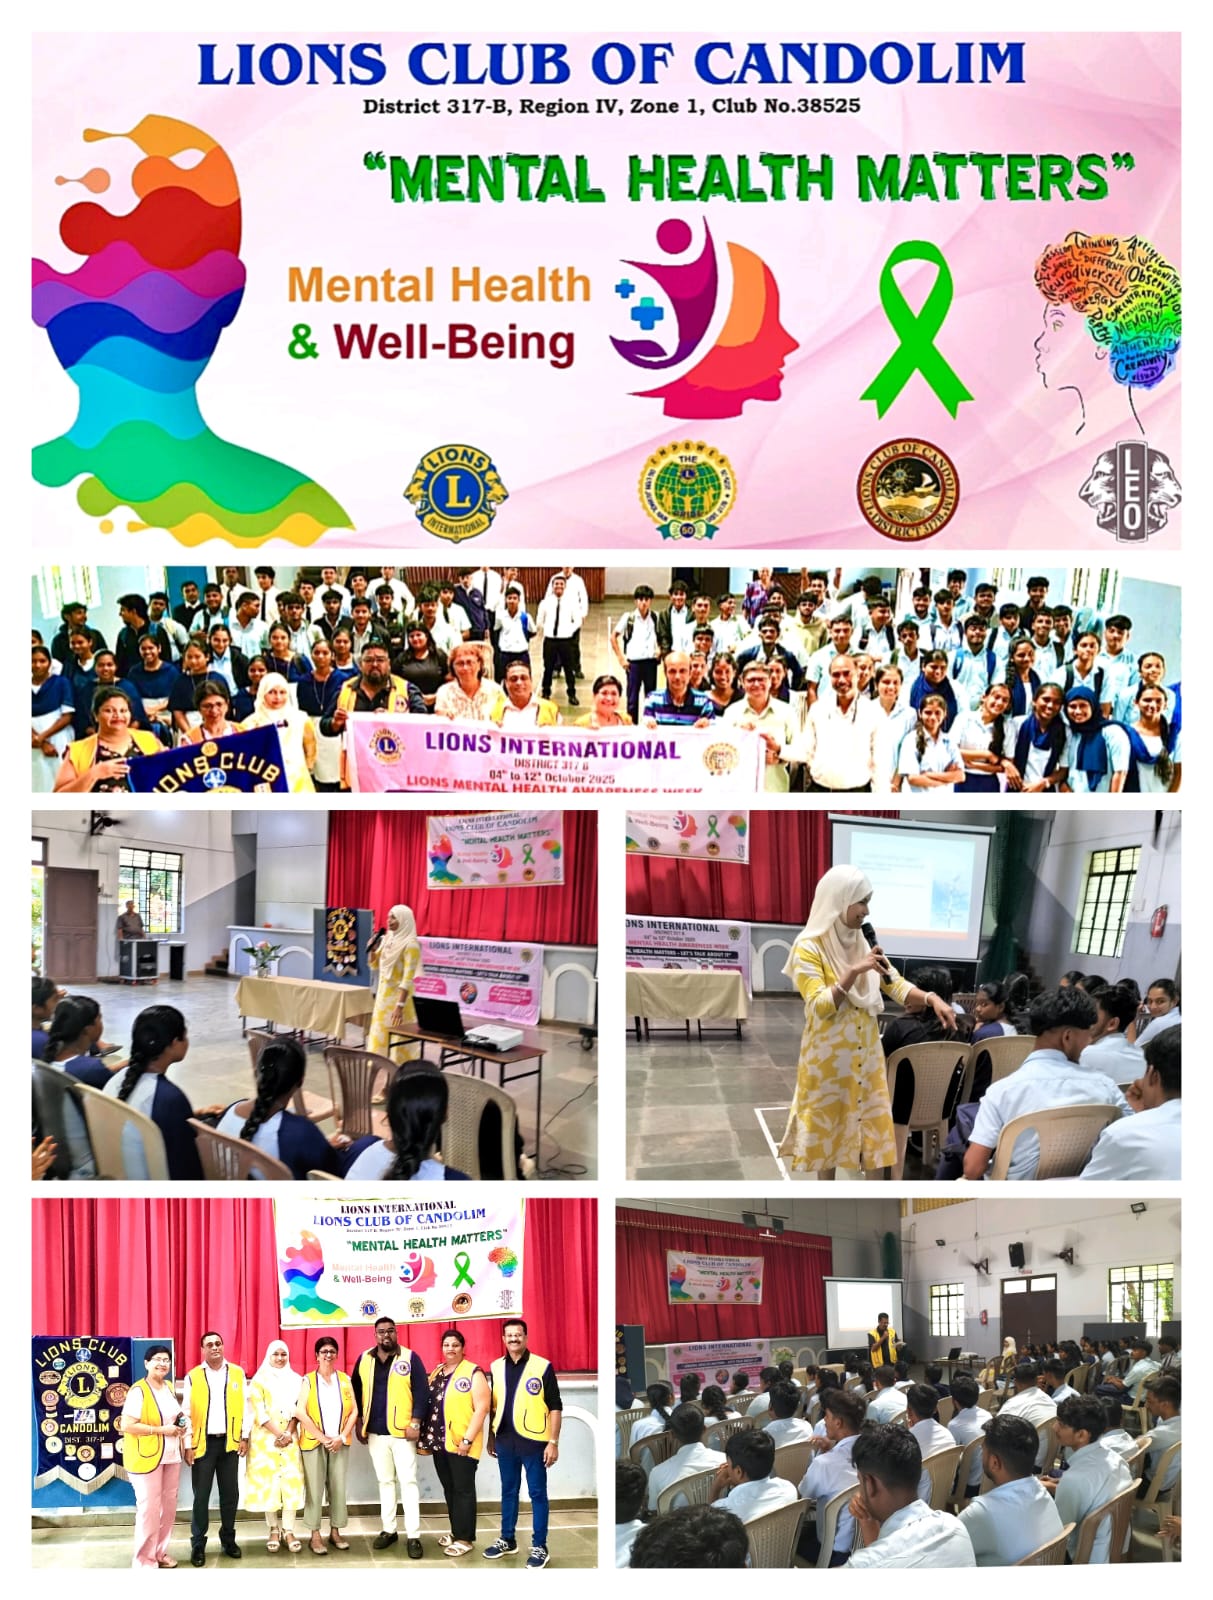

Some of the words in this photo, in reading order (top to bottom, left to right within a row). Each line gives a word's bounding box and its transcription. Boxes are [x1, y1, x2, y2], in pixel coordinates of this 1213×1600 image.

[197, 43, 386, 85] LIONS
[408, 42, 571, 85] CLUB
[591, 42, 675, 85] OF
[694, 42, 1026, 84] CANDOLIM
[363, 98, 440, 114] District
[446, 98, 512, 116] 317-B,
[520, 98, 590, 117] Region
[595, 98, 623, 116] IV,
[630, 98, 679, 114] Zone
[687, 98, 704, 116] 1,
[712, 97, 757, 114] Club
[764, 98, 860, 114] No.38525
[628, 152, 834, 203] HEALTH
[288, 266, 433, 302] Mental
[452, 266, 590, 302] Health
[288, 323, 319, 359] &
[333, 323, 575, 369] Well-Being
[427, 448, 486, 469] LIONS
[678, 455, 698, 463] THE
[861, 471, 873, 513] LIONS
[870, 445, 900, 470] CLUB
[902, 443, 920, 453] OF
[922, 447, 955, 512] CANDOLIM
[445, 475, 471, 507] L
[1123, 448, 1142, 530] LEO
[428, 517, 486, 535] INTERNATIONAL
[871, 512, 921, 537] DISTRICT
[381, 738, 395, 753] L
[425, 732, 491, 753] LIONS
[501, 737, 681, 760] INTERNATIONAL
[220, 752, 280, 782] CLUB
[514, 758, 558, 769] DISTRICT
[407, 775, 449, 787] LIONS
[453, 779, 508, 792] MENTAL
[513, 783, 567, 792] HEALTH
[510, 772, 521, 781] to
[545, 773, 586, 784] October
[589, 774, 615, 785] 2025
[647, 921, 720, 932] INTERNATIONAL
[429, 942, 450, 950] LIONS
[452, 943, 512, 954] INTERNATIONAL
[340, 1203, 370, 1214] LIONS
[373, 1200, 456, 1214] INTERNATIONAL
[314, 1214, 351, 1226] LIONS
[355, 1214, 391, 1227] CLUB
[395, 1213, 411, 1225] OF
[416, 1208, 486, 1225] CANDOLIM
[403, 1236, 447, 1250] HEALTH
[332, 1262, 362, 1272] Mental
[365, 1262, 396, 1272] Health
[333, 1274, 340, 1283] &
[342, 1274, 392, 1284] Well-Being
[35, 1337, 81, 1368] LIONS
[89, 1338, 128, 1367] CLUB
[708, 1342, 752, 1350] INTERNATIONAL
[67, 1363, 96, 1376] LIONS
[77, 1377, 90, 1393] L
[60, 1422, 109, 1433] CANDOLIM
